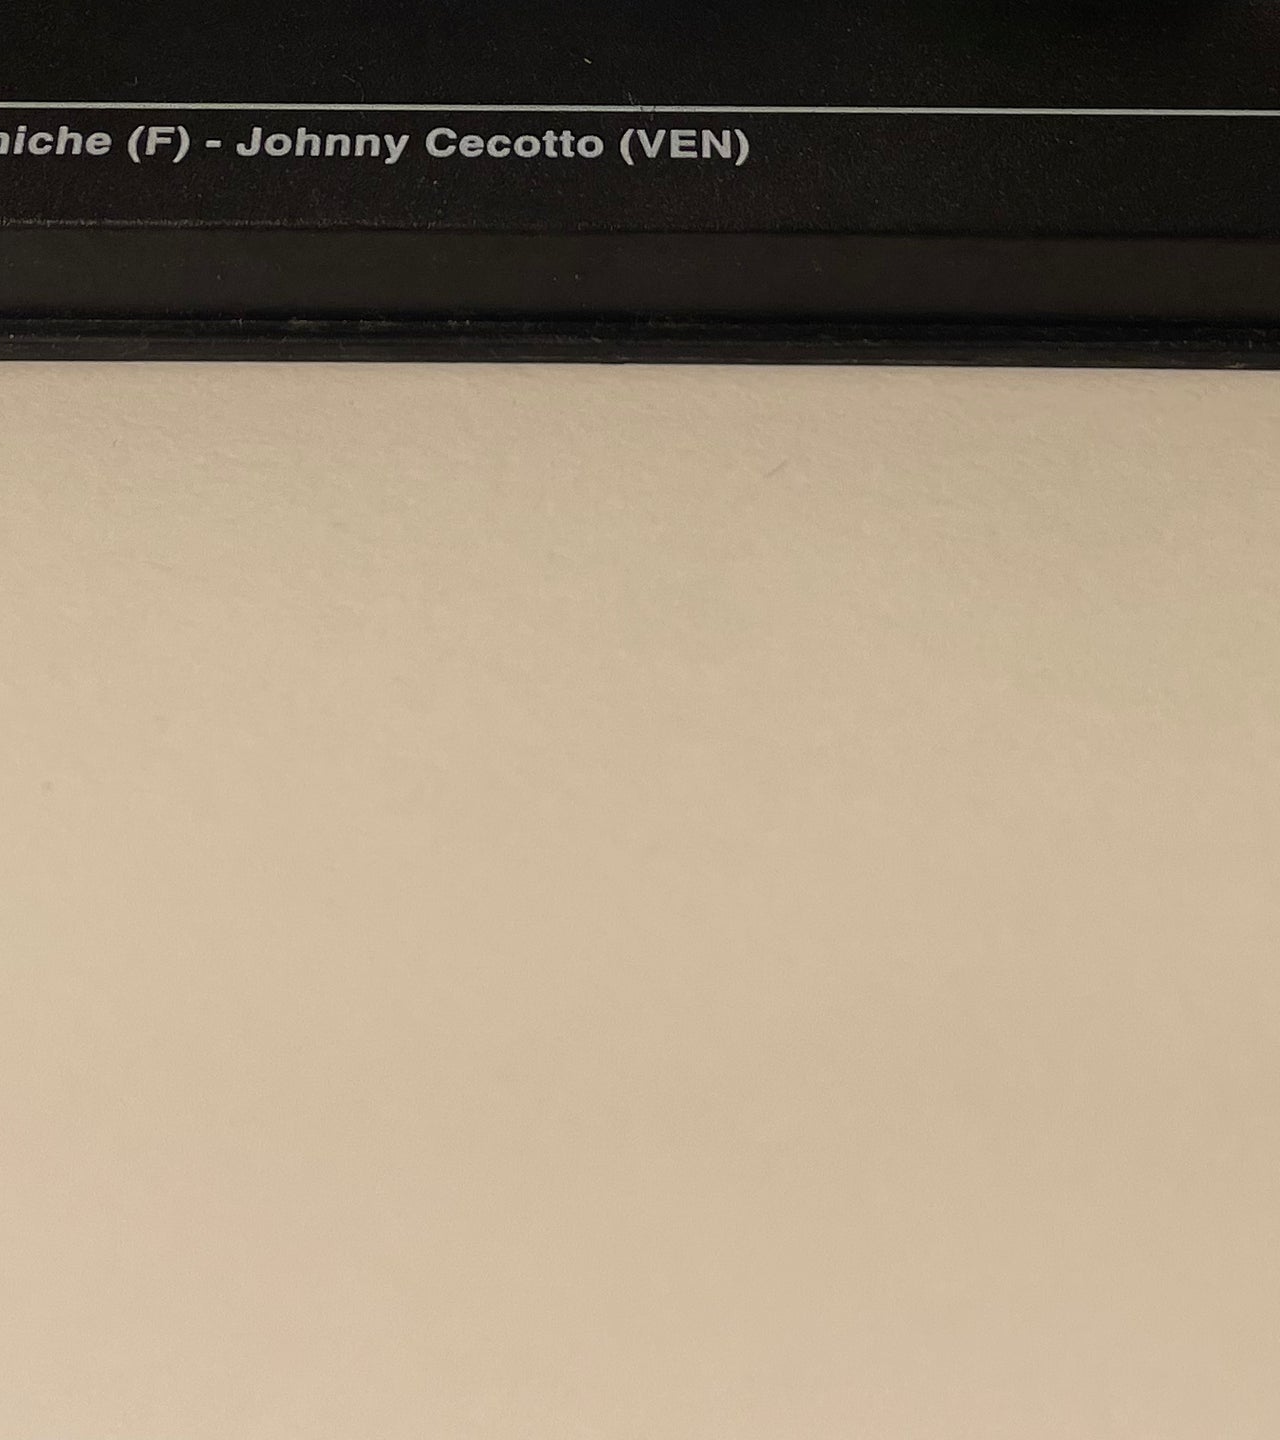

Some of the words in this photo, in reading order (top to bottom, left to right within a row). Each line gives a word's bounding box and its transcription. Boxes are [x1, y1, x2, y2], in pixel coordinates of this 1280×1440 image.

[128, 125, 190, 163] (F)
[206, 139, 222, 148] -
[236, 126, 410, 165] Johnny
[425, 127, 604, 158] Cecotto
[620, 128, 750, 166] (VEN)
